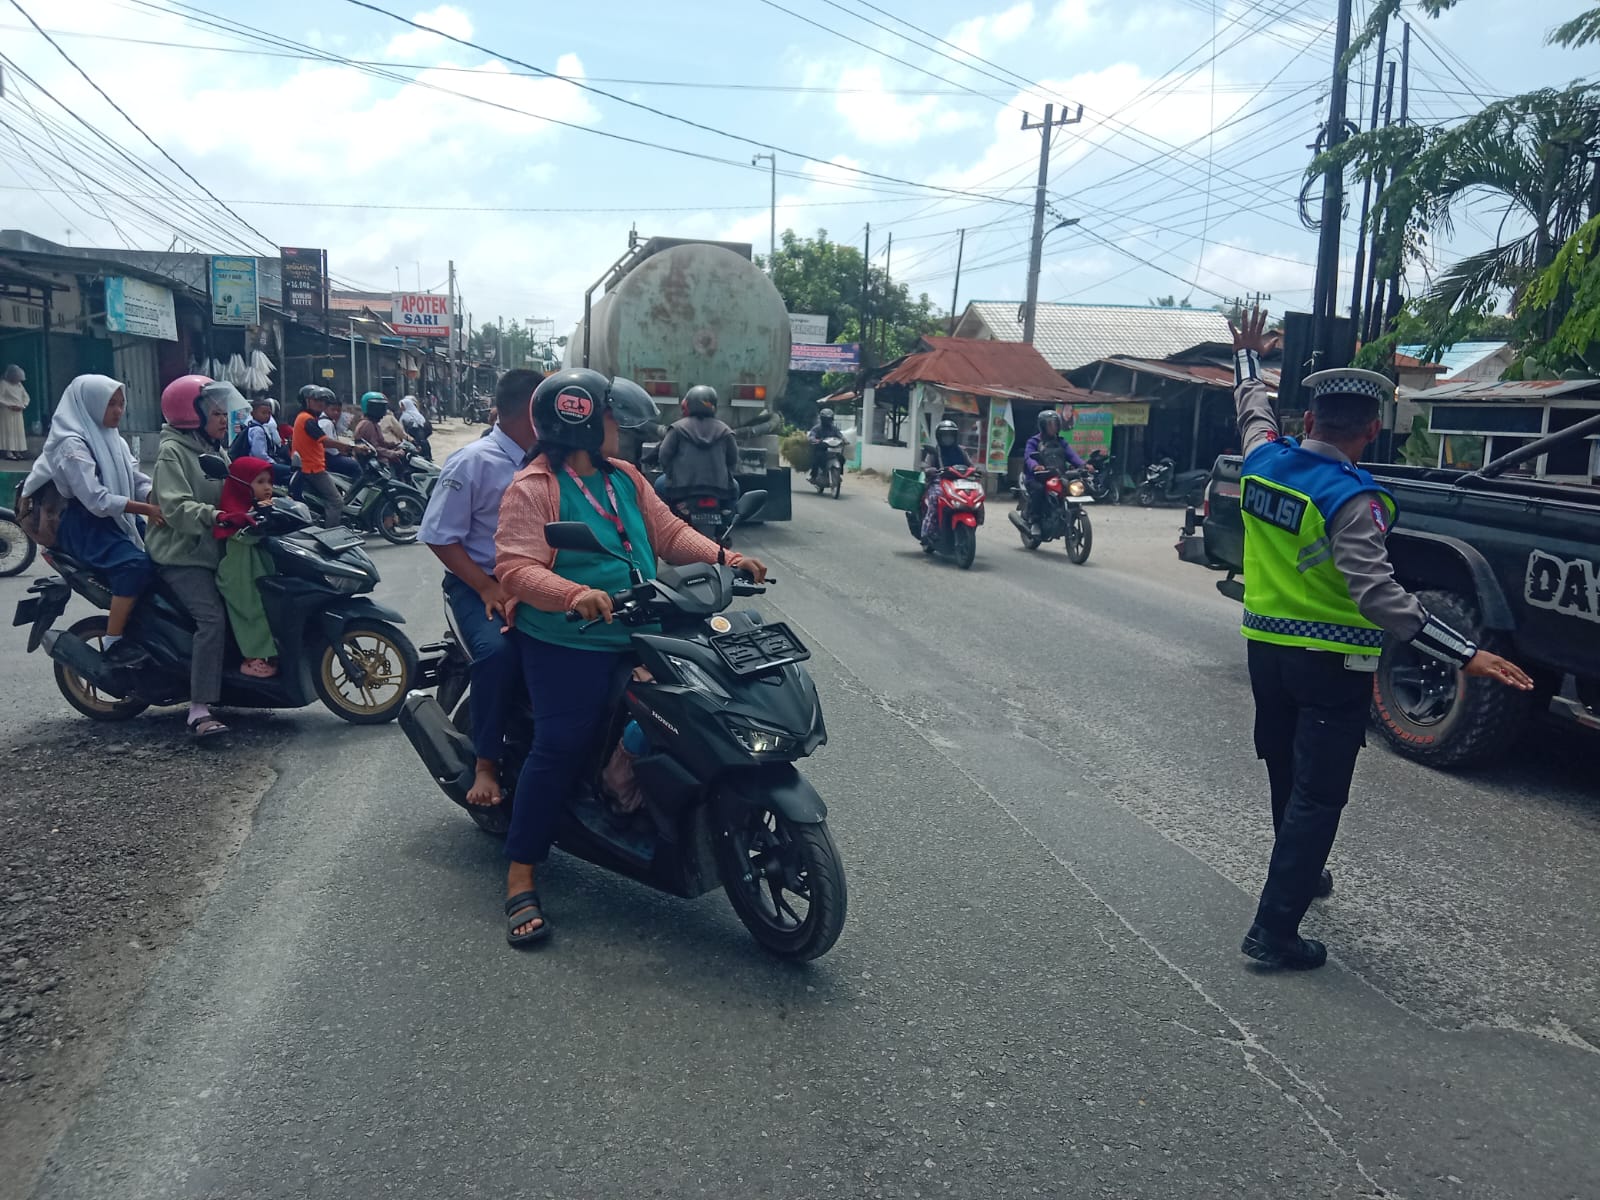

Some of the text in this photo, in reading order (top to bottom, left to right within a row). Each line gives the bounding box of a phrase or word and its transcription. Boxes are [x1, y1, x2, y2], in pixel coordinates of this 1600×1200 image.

[401, 295, 448, 315] APOTEK
[404, 313, 439, 326] SARI
[1244, 485, 1301, 531] POLISI
[1524, 548, 1600, 624] DA
[651, 710, 680, 735] HONDA
